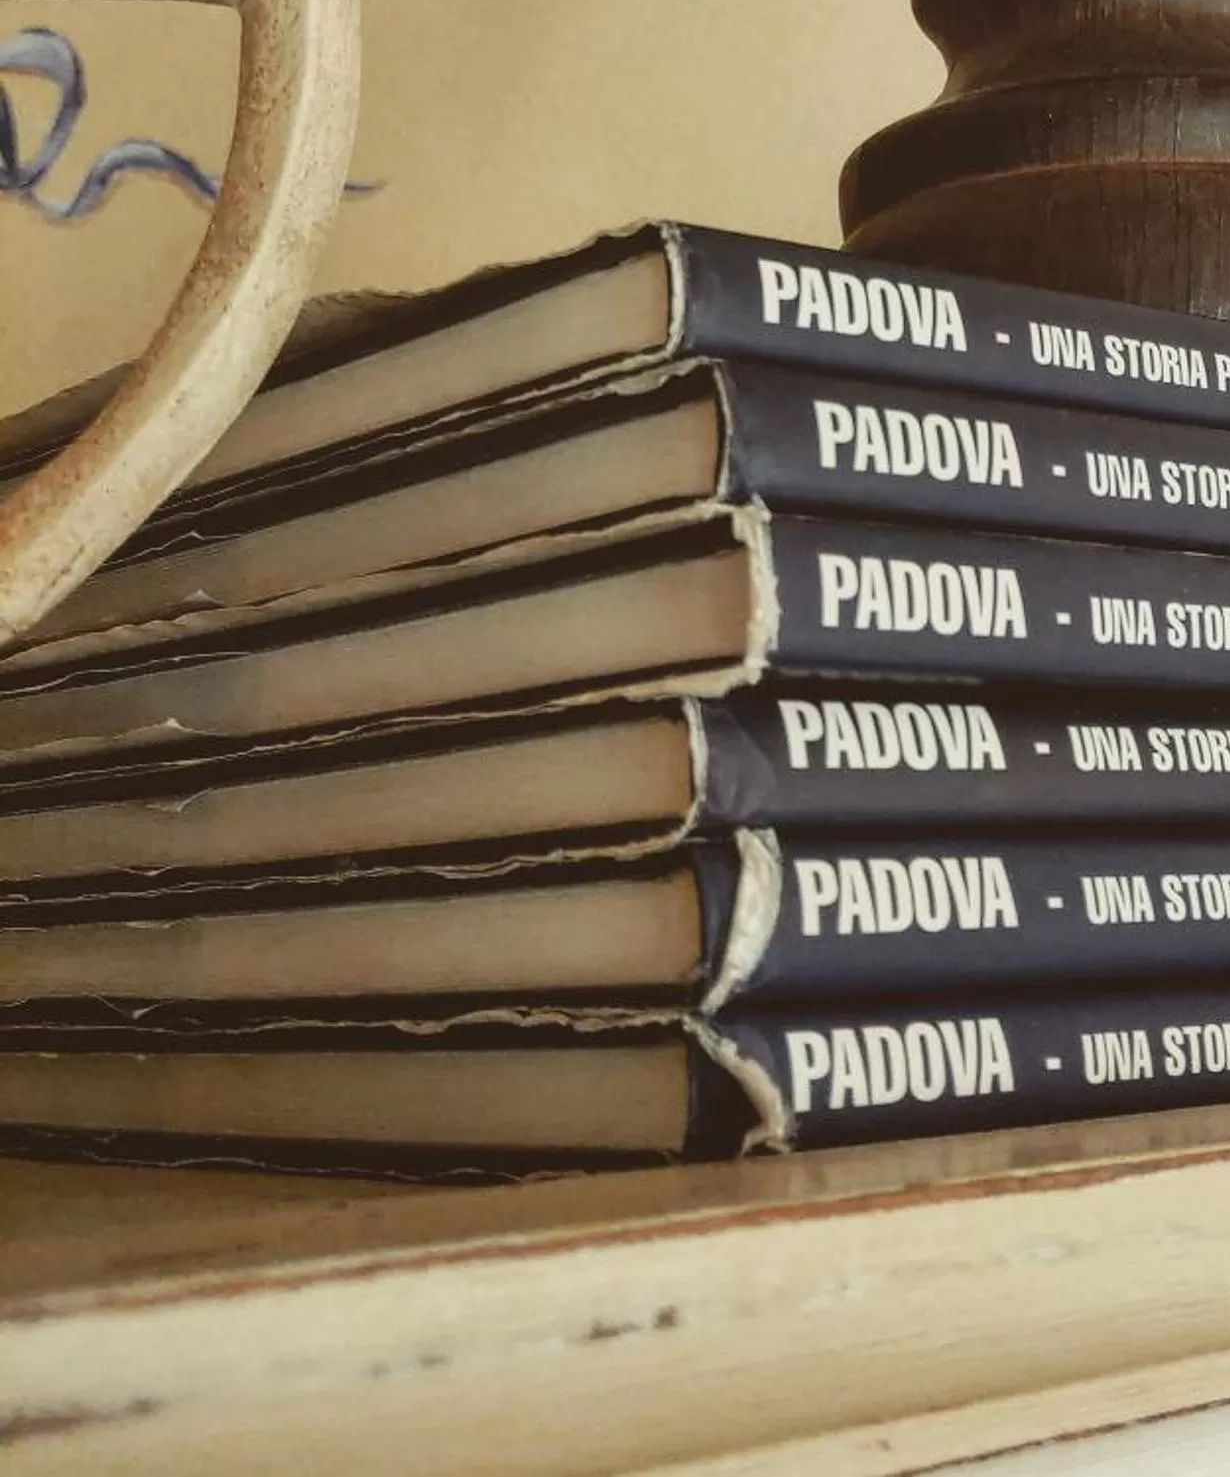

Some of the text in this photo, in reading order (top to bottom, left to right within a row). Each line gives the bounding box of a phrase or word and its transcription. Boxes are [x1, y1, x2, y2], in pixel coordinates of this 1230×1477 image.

[758, 258, 968, 352] PADOVA
[1028, 321, 1096, 372] UNA
[1103, 335, 1209, 390] STORIA
[813, 400, 1024, 488] PADOVA
[1085, 451, 1153, 501] UNA
[818, 553, 1028, 639] PADOVA
[1090, 596, 1157, 646] UNA
[778, 700, 1007, 771] PADOVA
[1067, 725, 1143, 772] UNA
[794, 856, 1019, 936] PADOVA
[1081, 875, 1155, 925] UNA
[787, 1017, 1014, 1113] PADOVA
[1081, 1029, 1154, 1084] UNA
